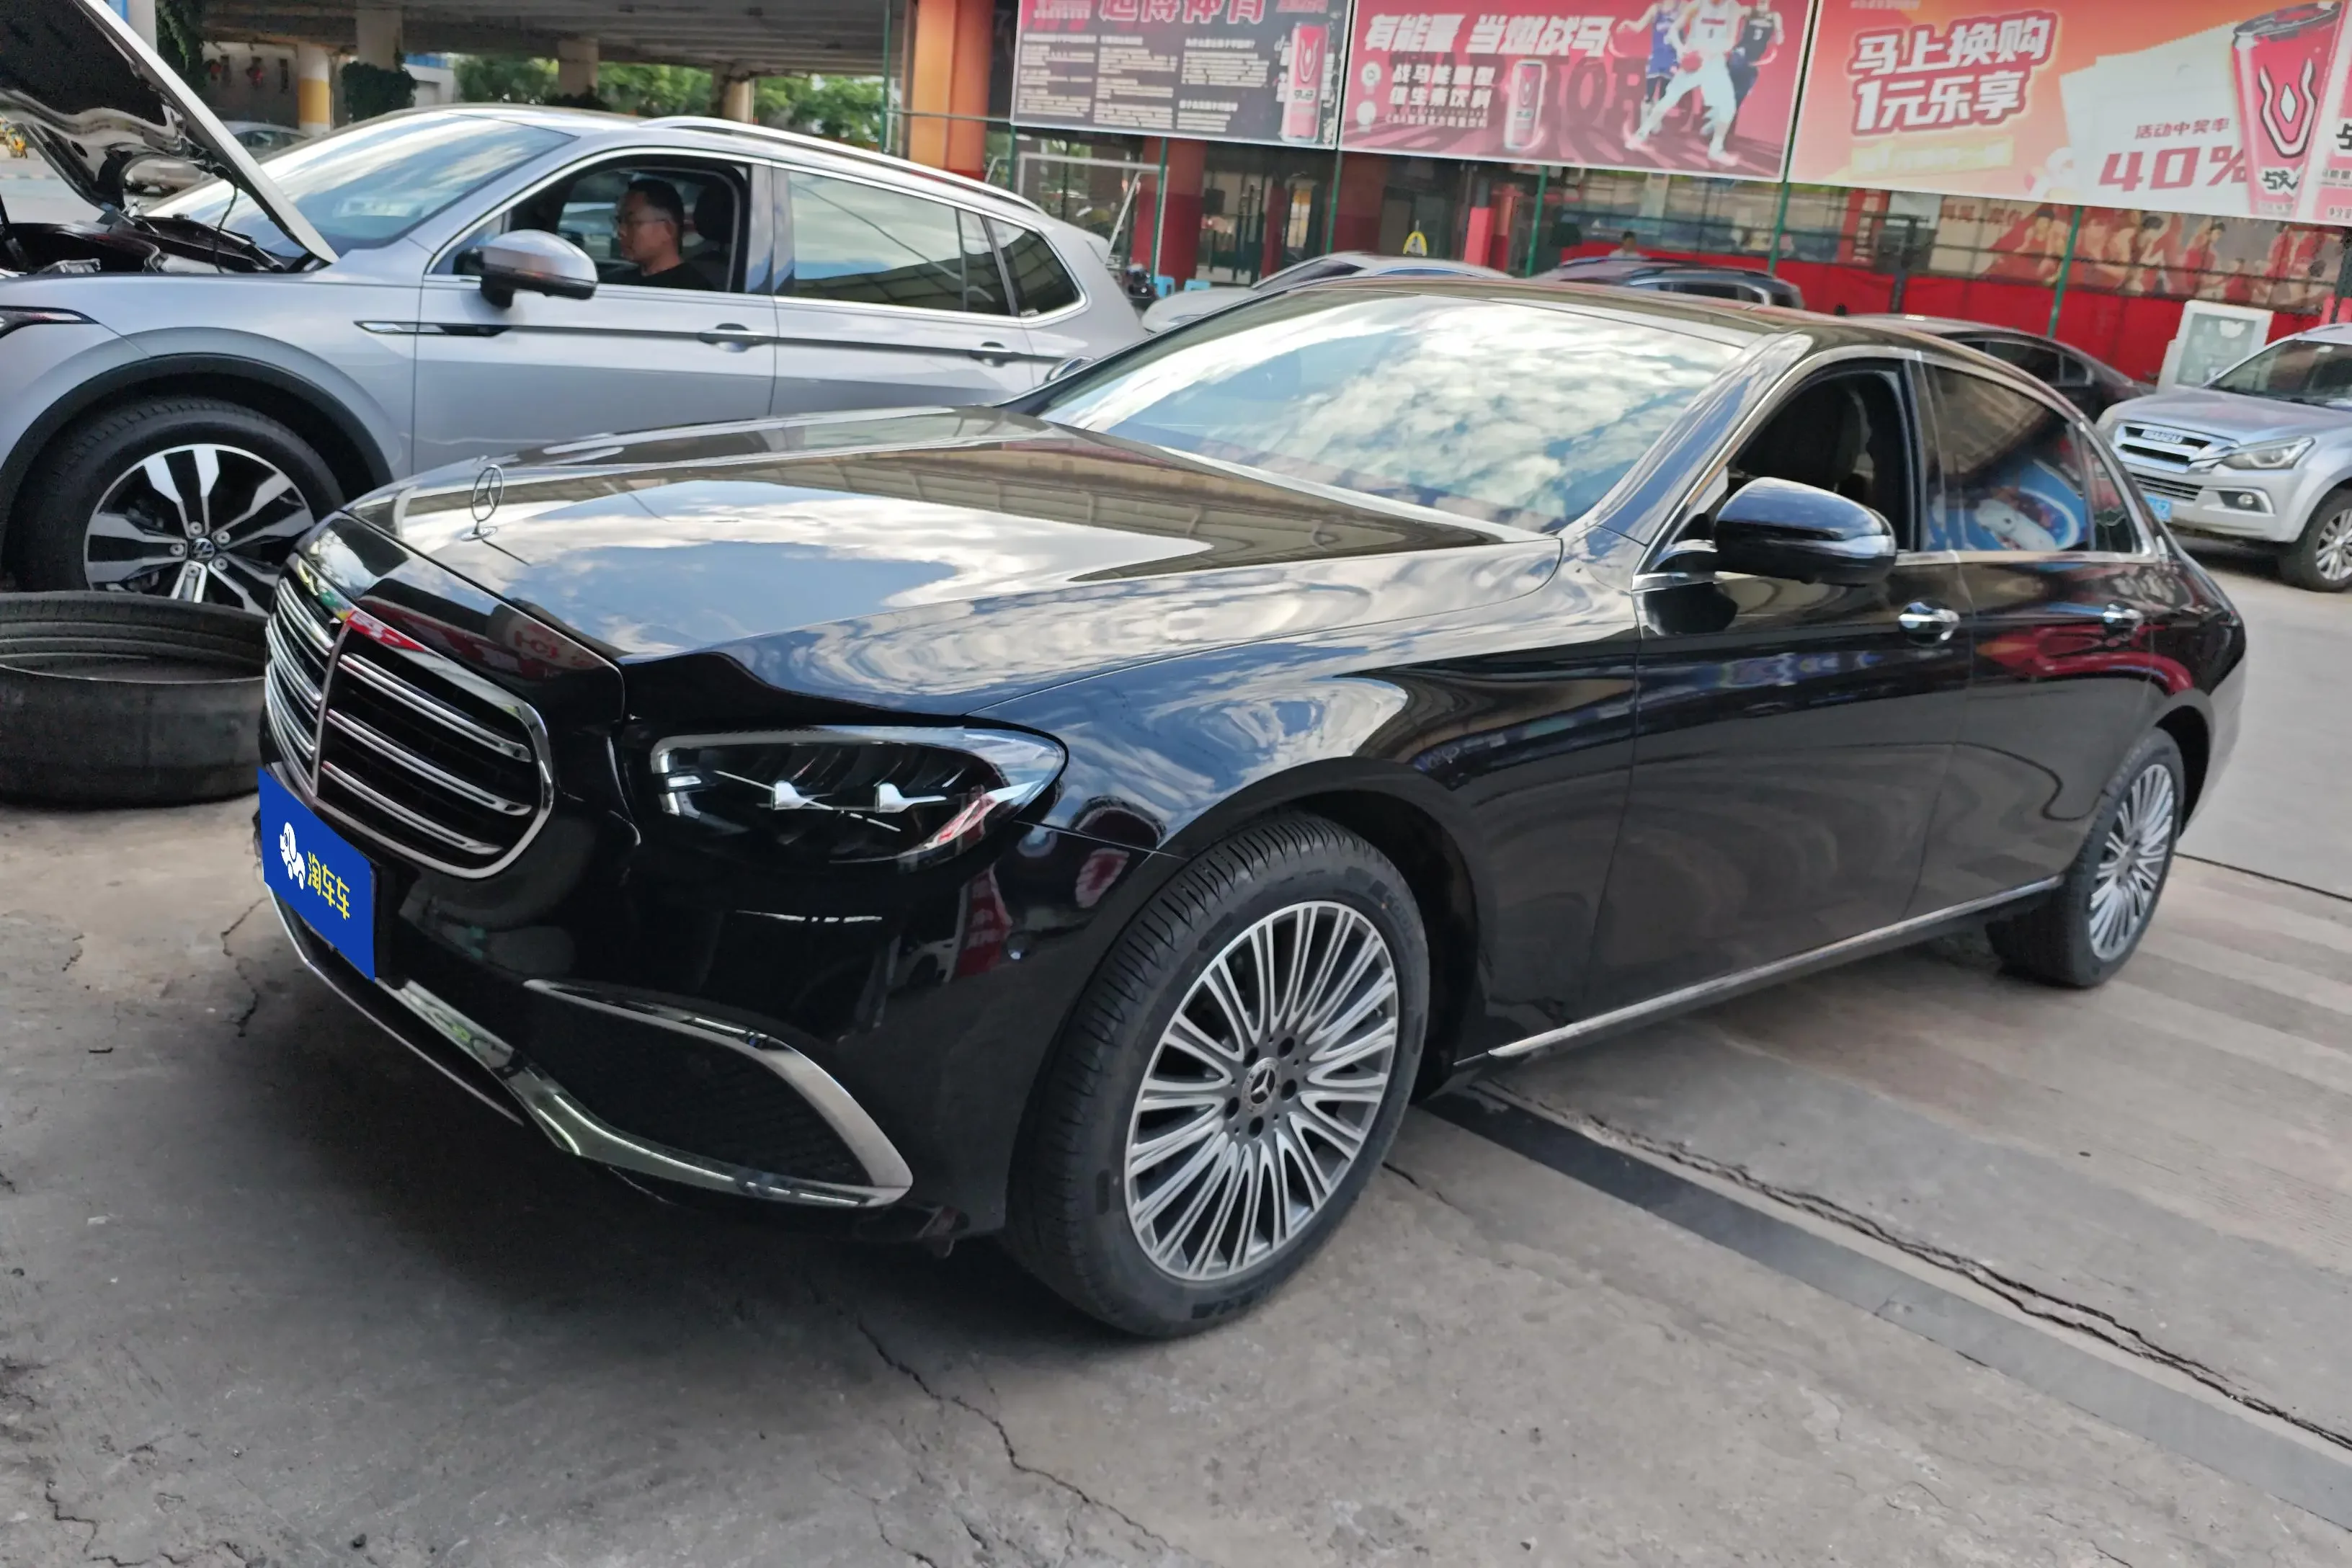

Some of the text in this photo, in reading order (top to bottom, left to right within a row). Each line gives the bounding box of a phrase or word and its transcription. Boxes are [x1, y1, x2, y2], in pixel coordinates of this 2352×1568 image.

[1850, 17, 2052, 76] 马上换购
[1856, 71, 2024, 130] 1元乐享
[2135, 117, 2230, 139] 活动中奖率
[2098, 146, 2247, 192] 40%
